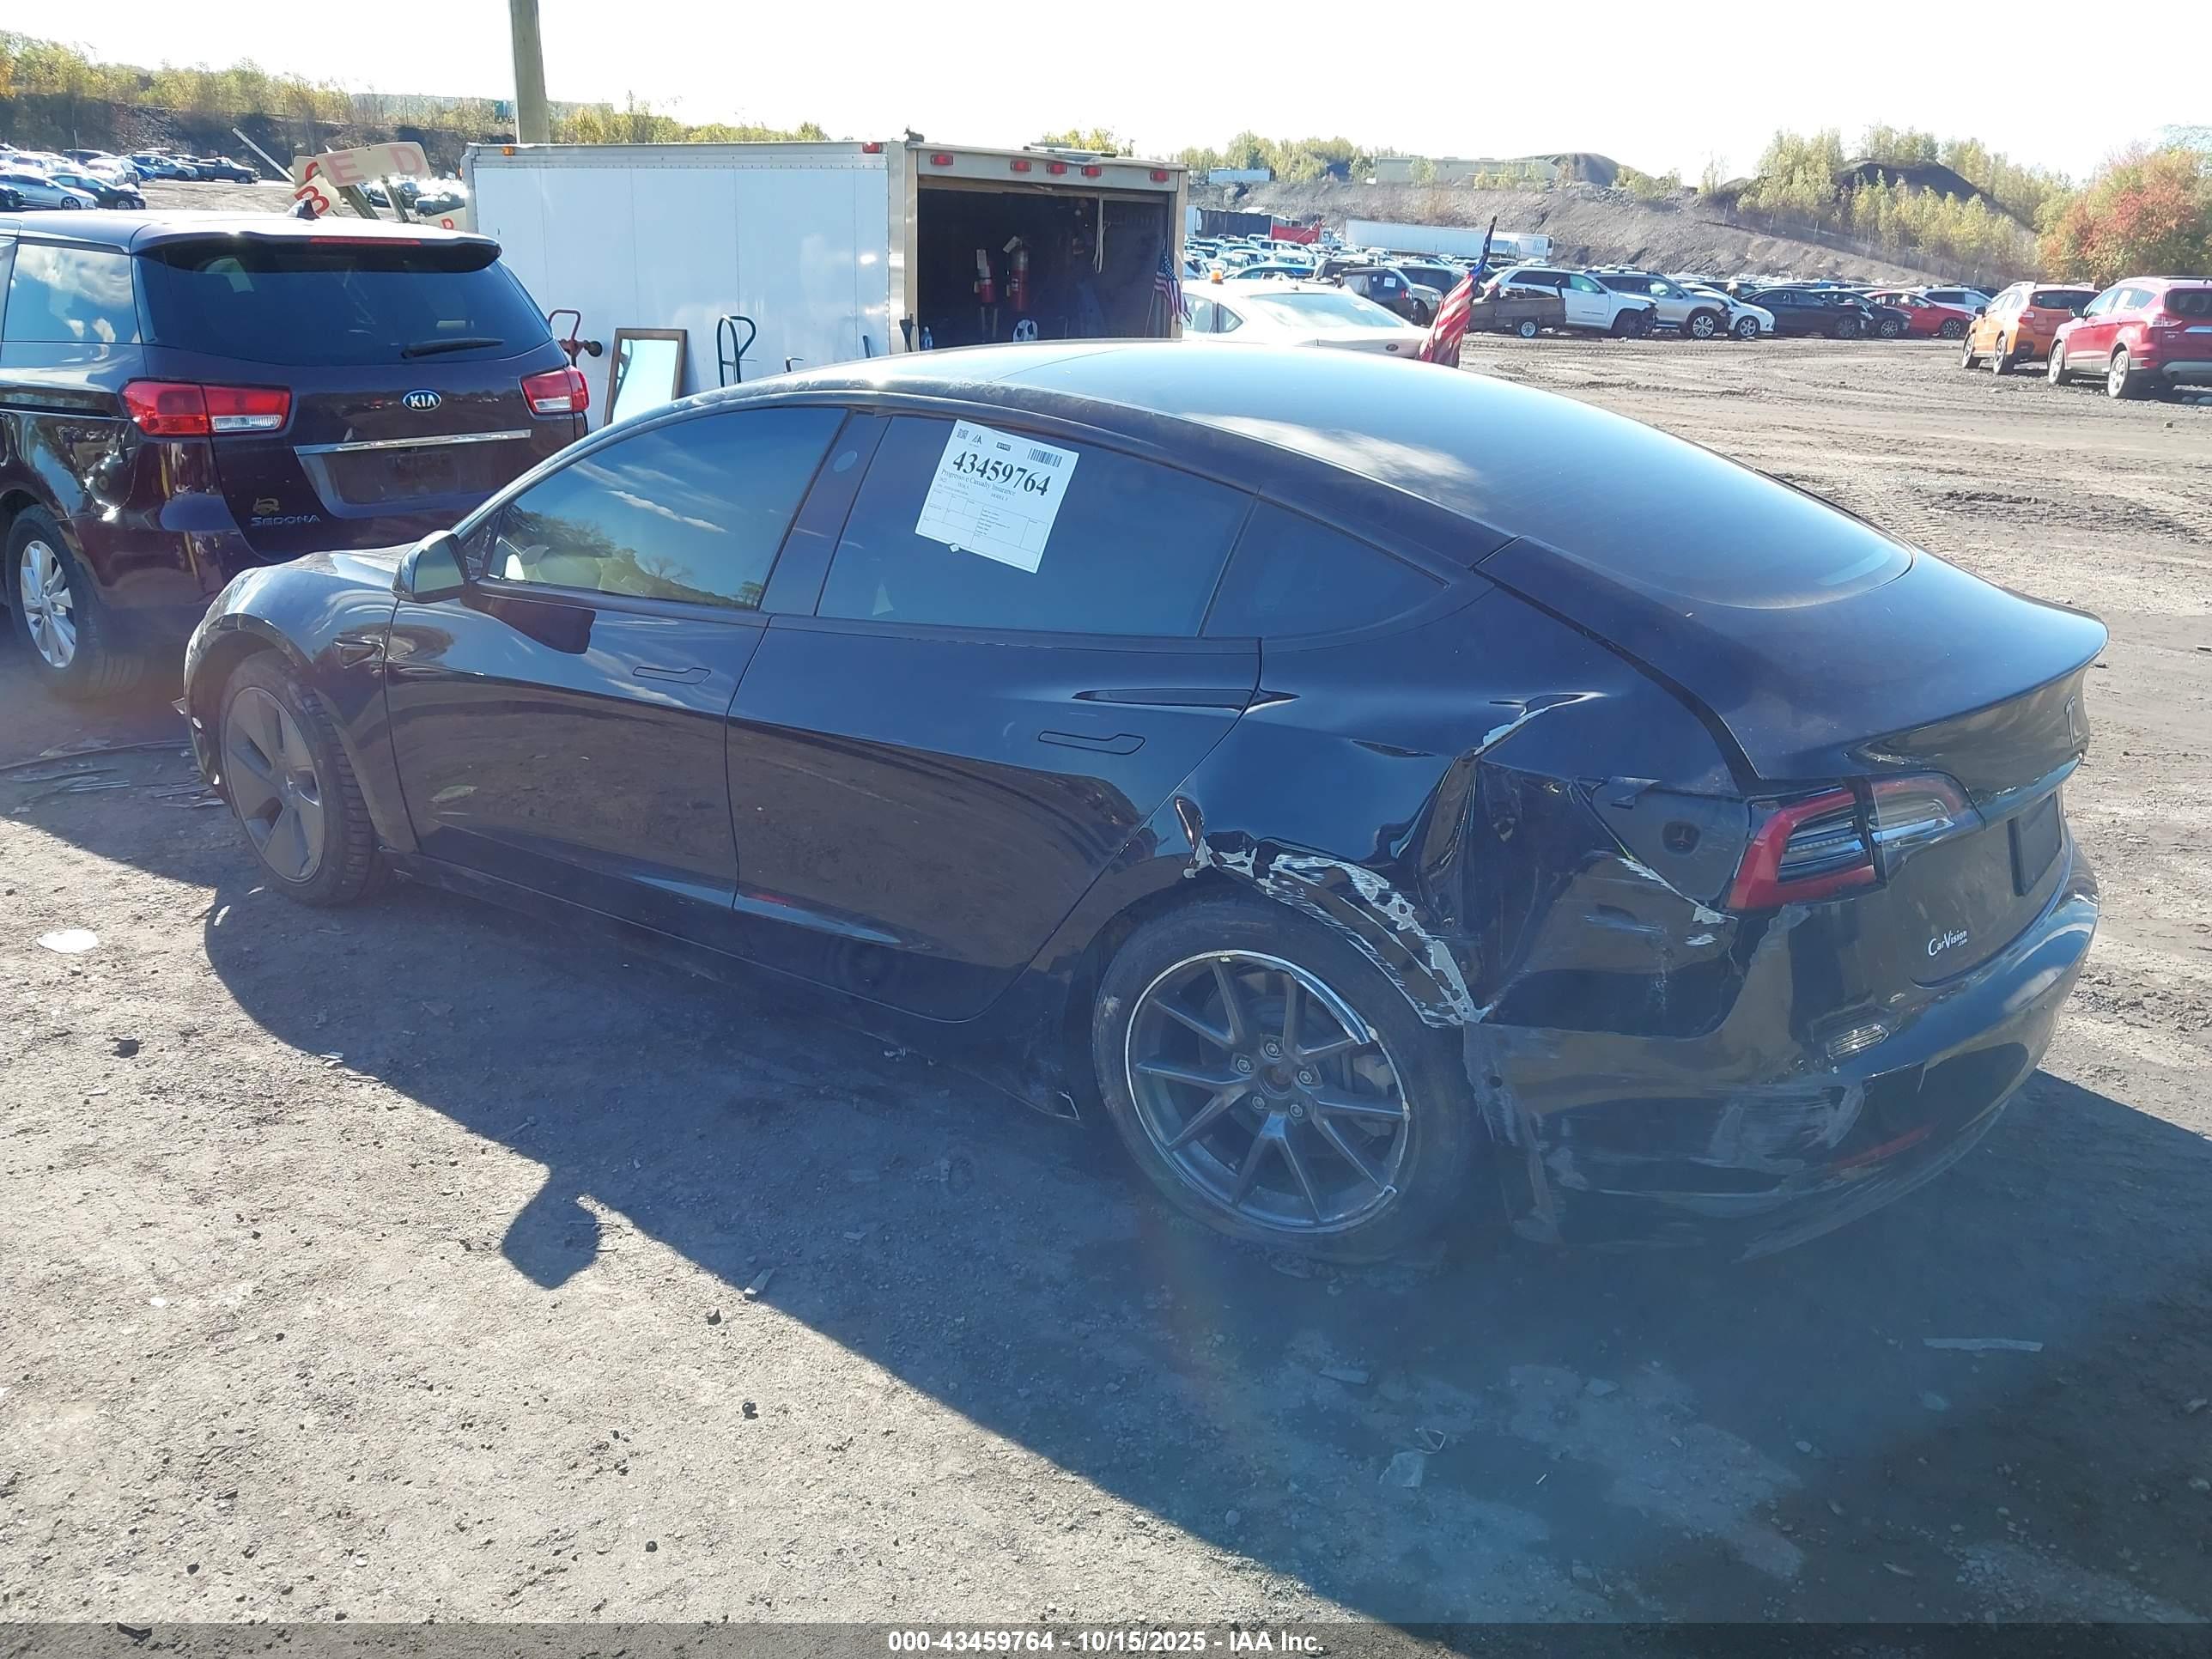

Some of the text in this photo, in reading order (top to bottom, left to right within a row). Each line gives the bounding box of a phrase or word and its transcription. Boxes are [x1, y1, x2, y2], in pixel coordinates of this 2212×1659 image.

[410, 394, 437, 408] KIA
[953, 451, 1051, 496] 43459764
[251, 515, 321, 527] SEDONA
[1928, 930, 1967, 956] CarVision
